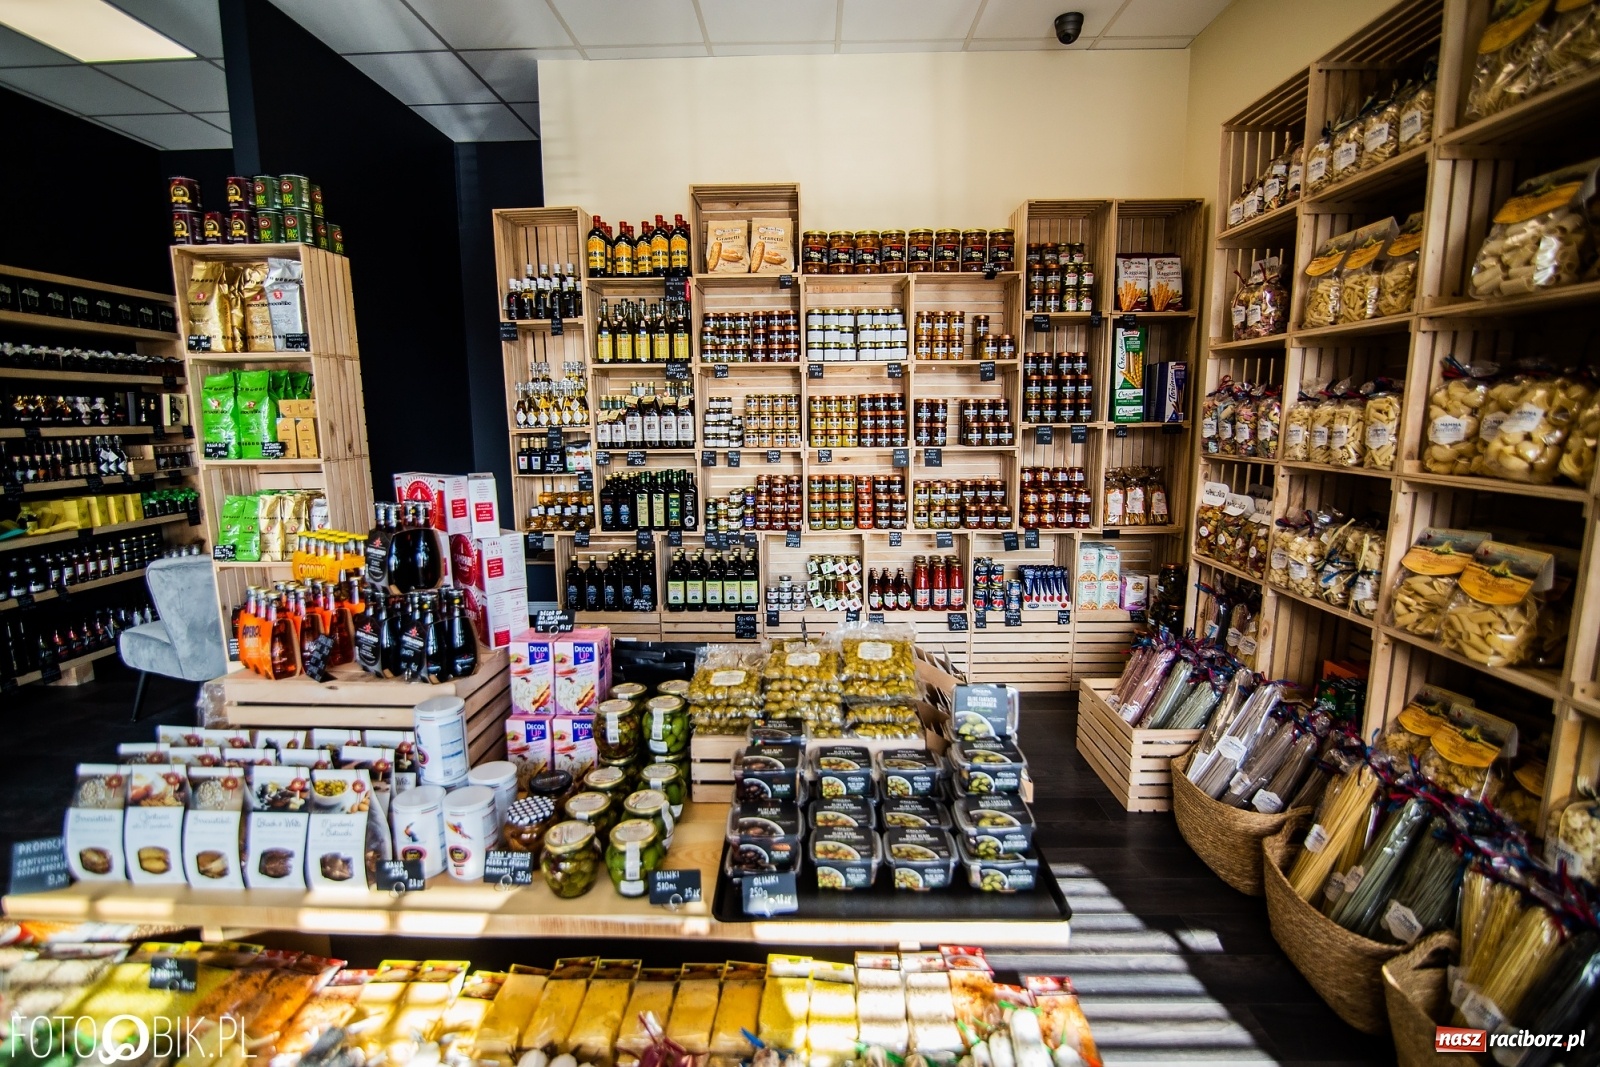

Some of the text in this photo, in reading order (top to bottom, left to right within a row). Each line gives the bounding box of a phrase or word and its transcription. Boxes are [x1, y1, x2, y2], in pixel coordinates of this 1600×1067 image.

[298, 563, 326, 578] CRODINO
[531, 729, 542, 737] UP
[656, 870, 680, 880] OLIWKI
[753, 876, 779, 886] OLIWKI
[750, 887, 768, 899] 250g
